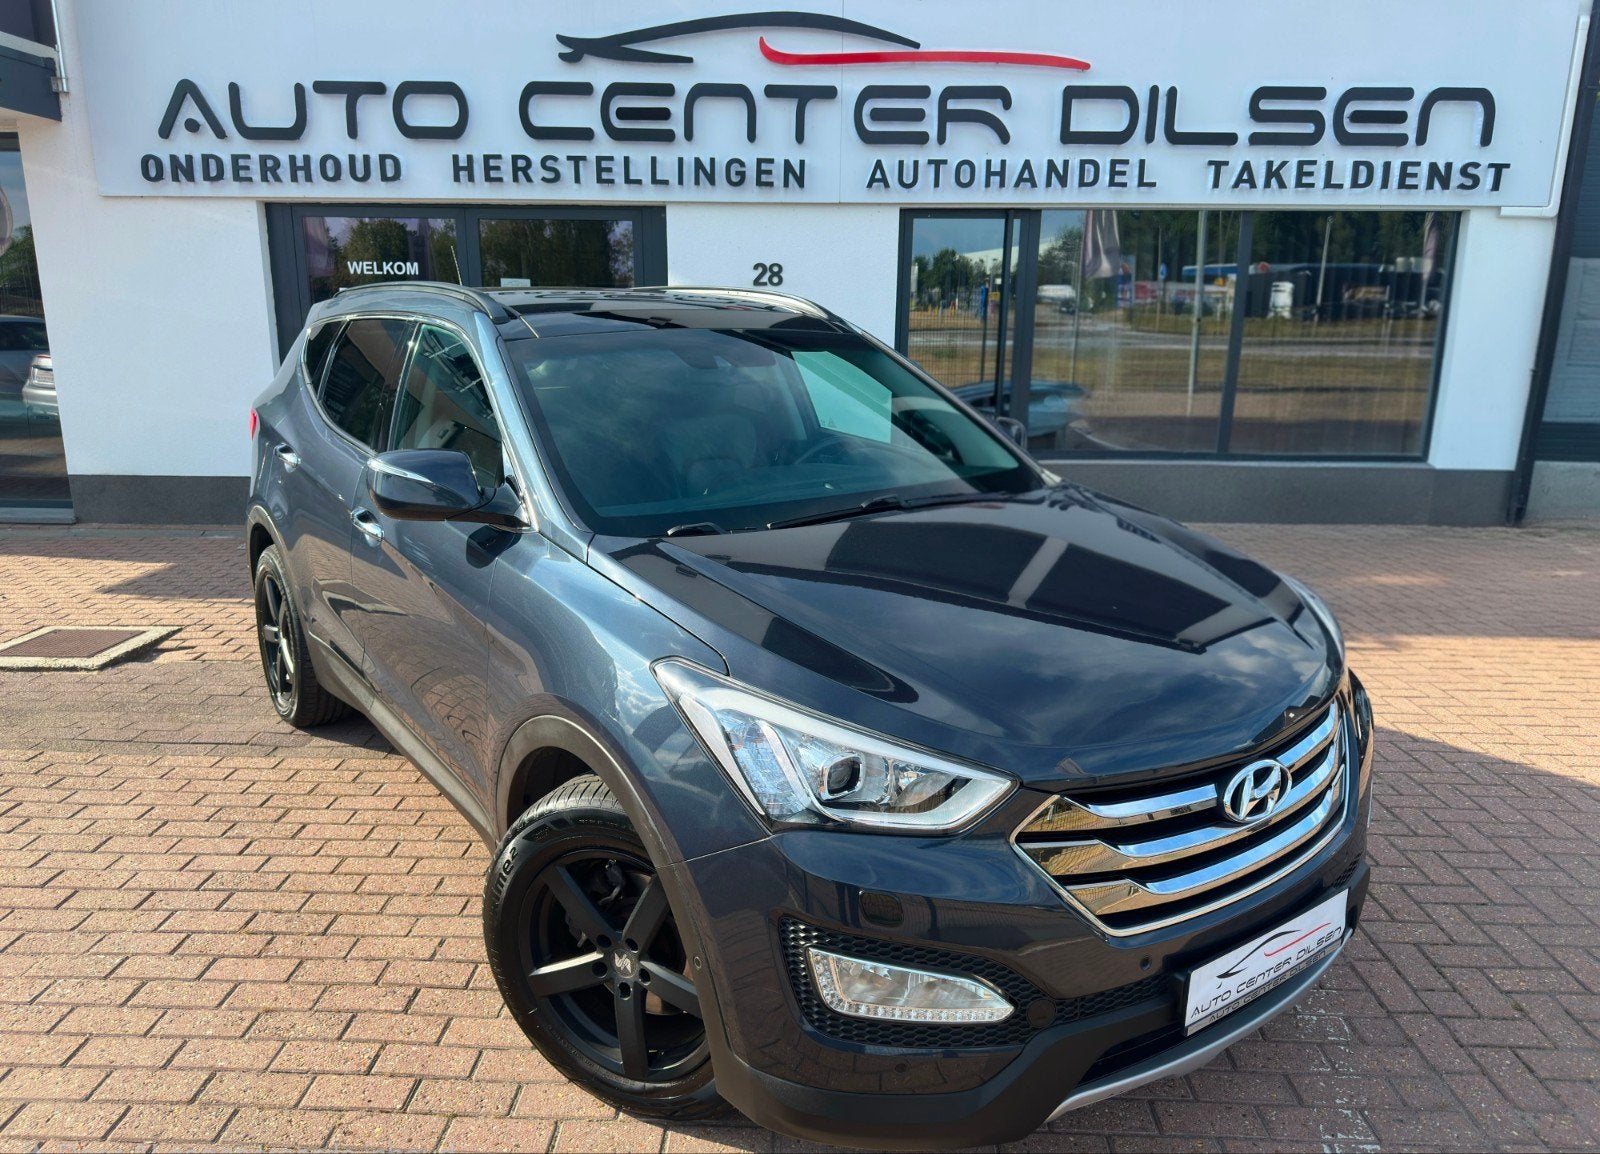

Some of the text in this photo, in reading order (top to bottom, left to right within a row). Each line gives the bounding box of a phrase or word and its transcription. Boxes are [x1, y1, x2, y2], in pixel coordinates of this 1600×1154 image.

[157, 78, 1496, 148] AUTO CENTER DILSEN
[140, 153, 1511, 192] ONDERHOUD HERSTELLINGEN AUTOHANDEL TAKELDIENST
[347, 261, 419, 275] WELKOM
[753, 262, 784, 287] 28
[1190, 926, 1342, 1018] AUTO CENTER DILSEN
